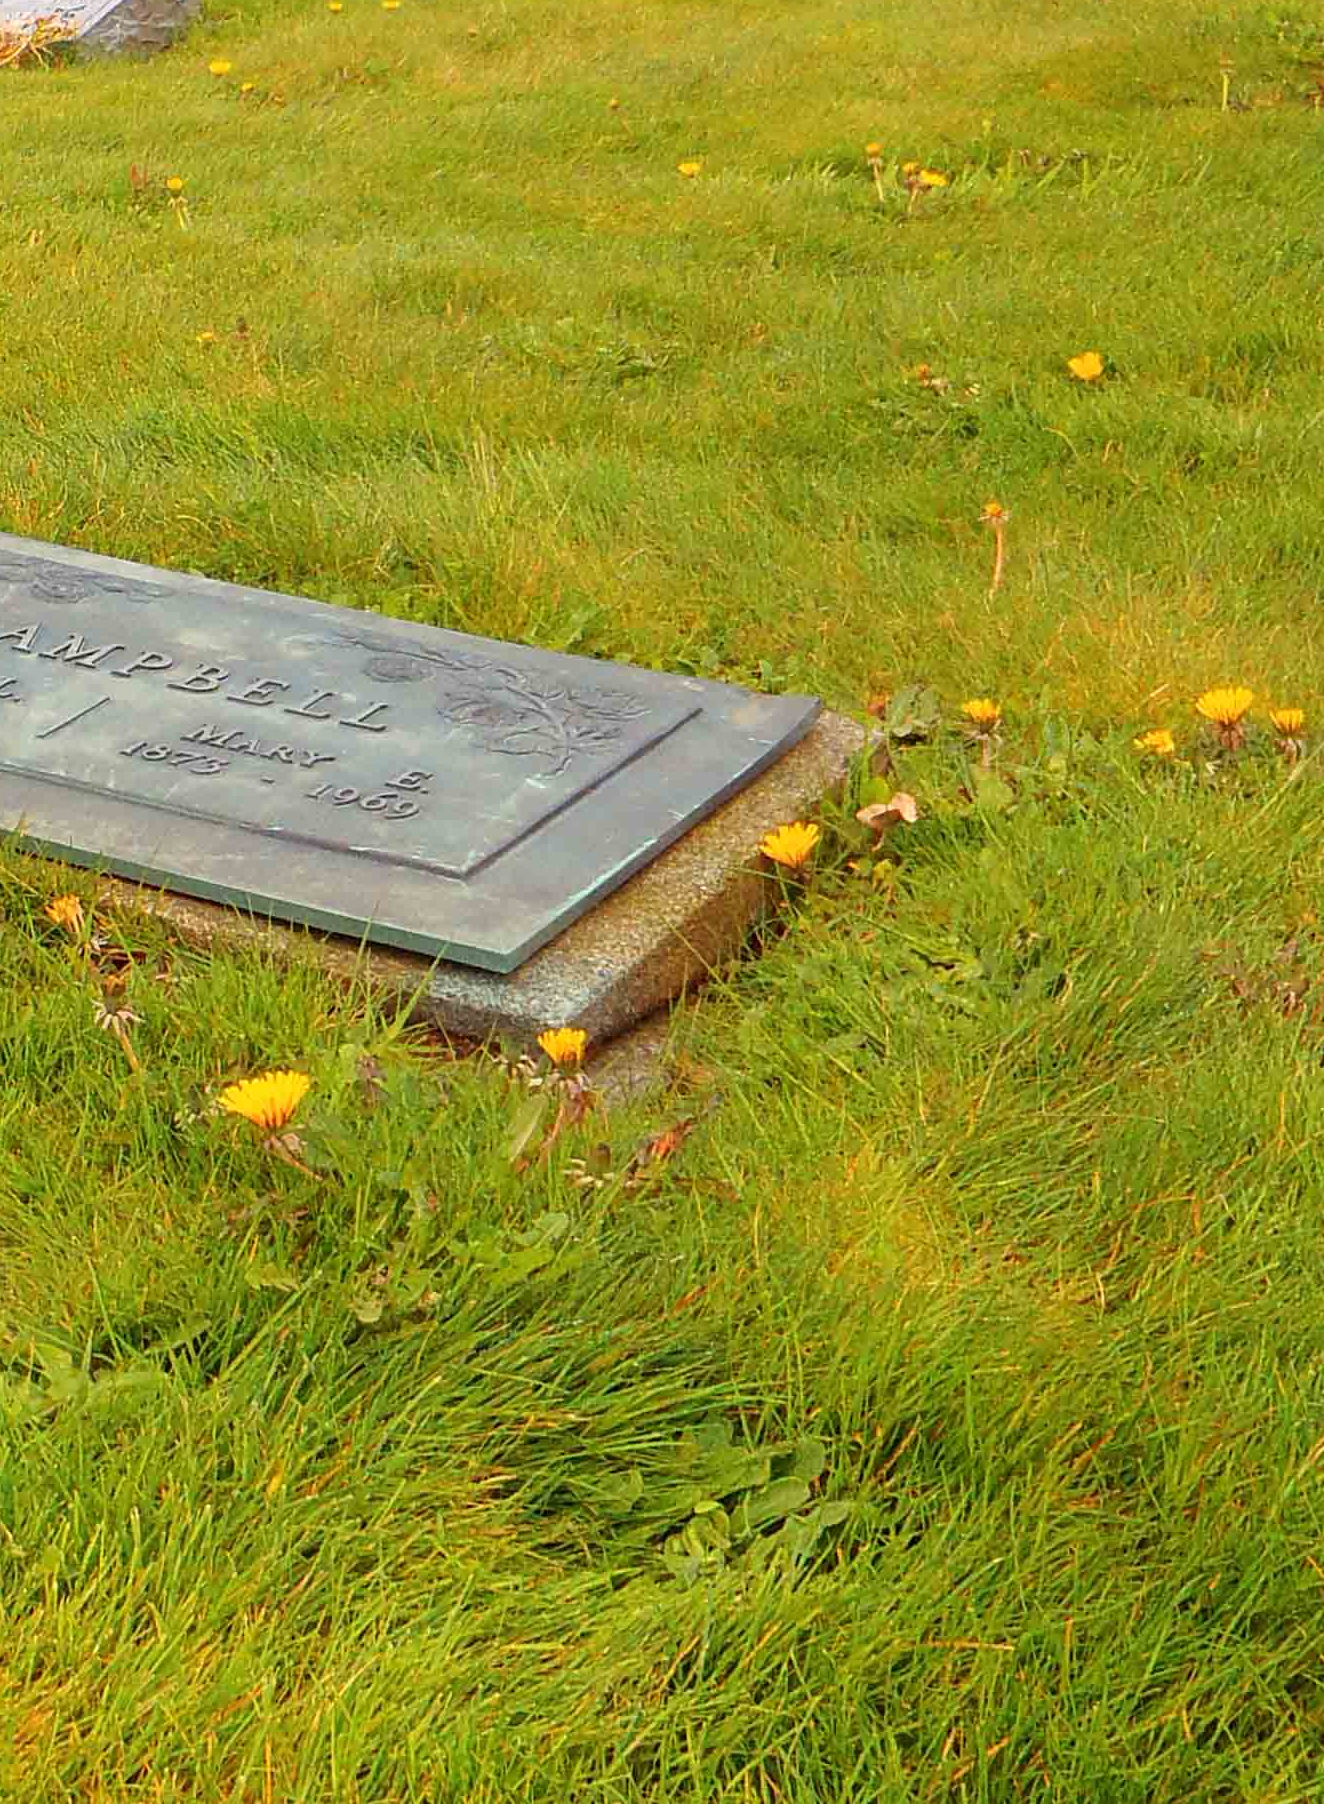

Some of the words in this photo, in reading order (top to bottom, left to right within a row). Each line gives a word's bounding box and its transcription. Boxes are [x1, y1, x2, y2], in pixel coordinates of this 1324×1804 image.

[120, 740, 231, 775] 1873
[304, 783, 422, 821] 1969
[180, 722, 337, 769] MARY
[385, 769, 434, 795] E.
